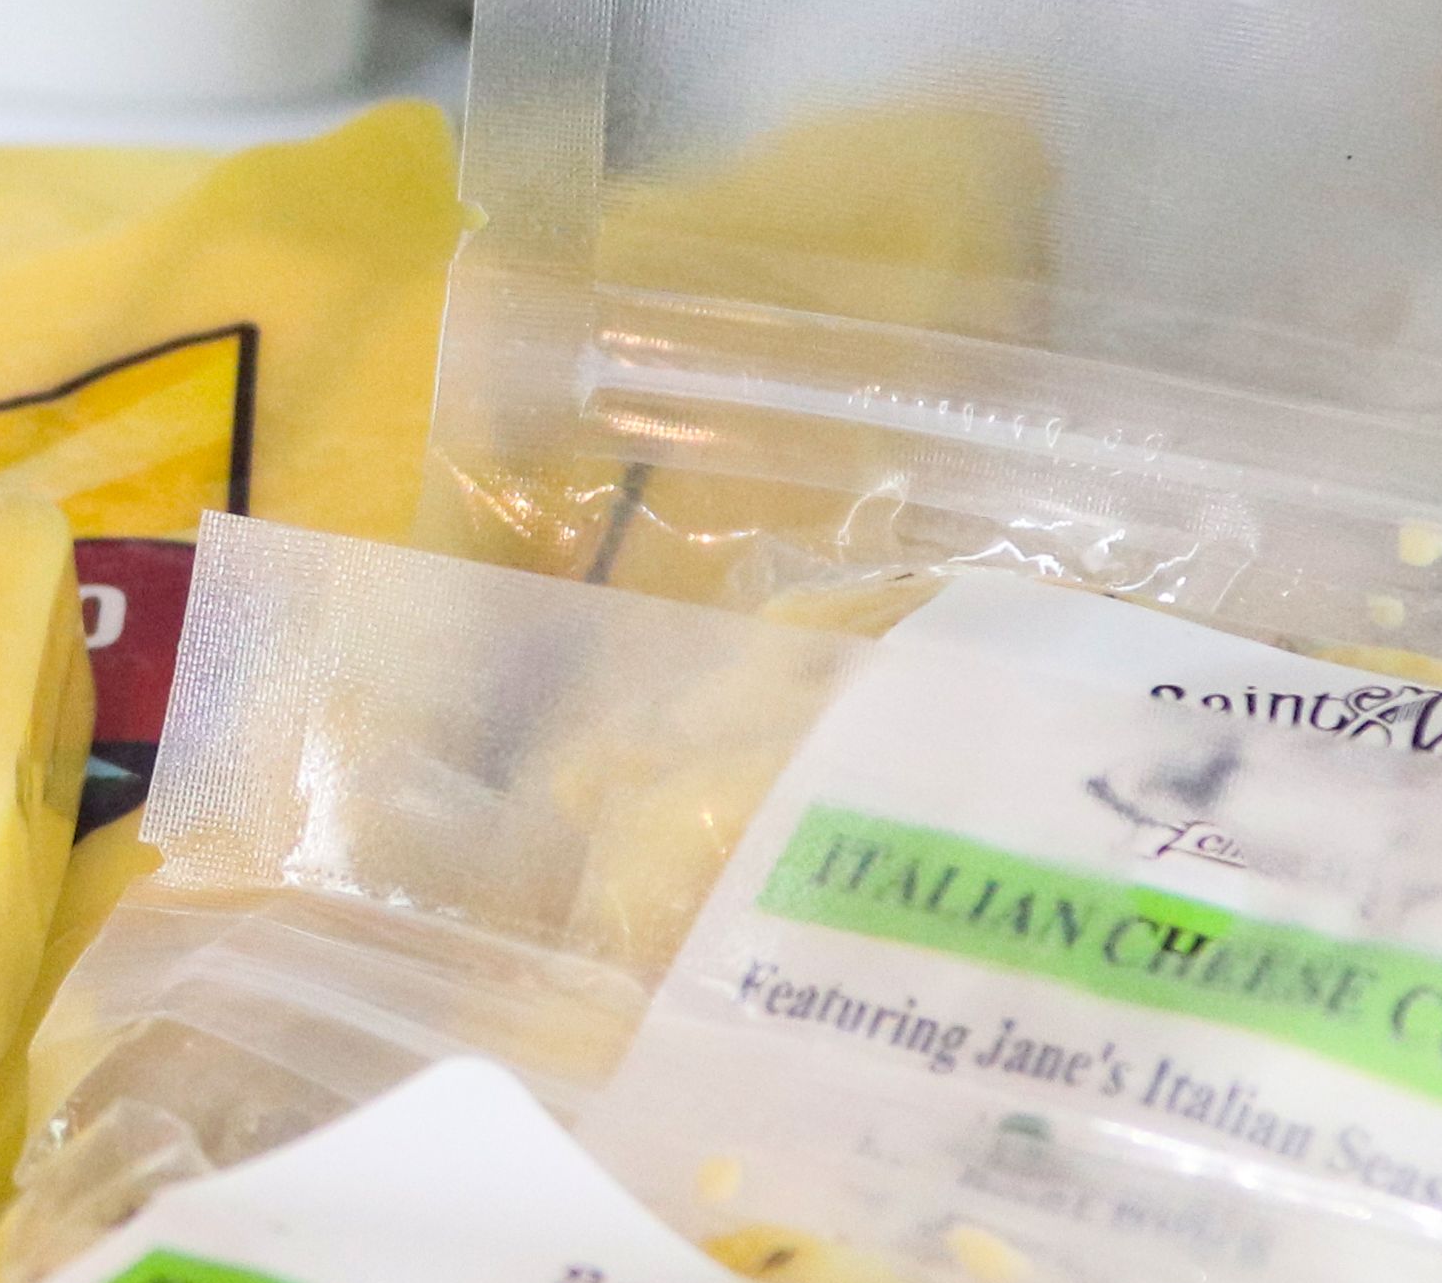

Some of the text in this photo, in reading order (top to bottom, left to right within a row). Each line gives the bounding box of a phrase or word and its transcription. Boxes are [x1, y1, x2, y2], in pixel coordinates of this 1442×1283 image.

[811, 829, 1088, 950] ITALIAN
[1103, 913, 1380, 1020] CHEESE
[734, 957, 971, 1076] Featuring
[974, 1015, 1128, 1099] Jane's
[1138, 1055, 1316, 1164] Italian
